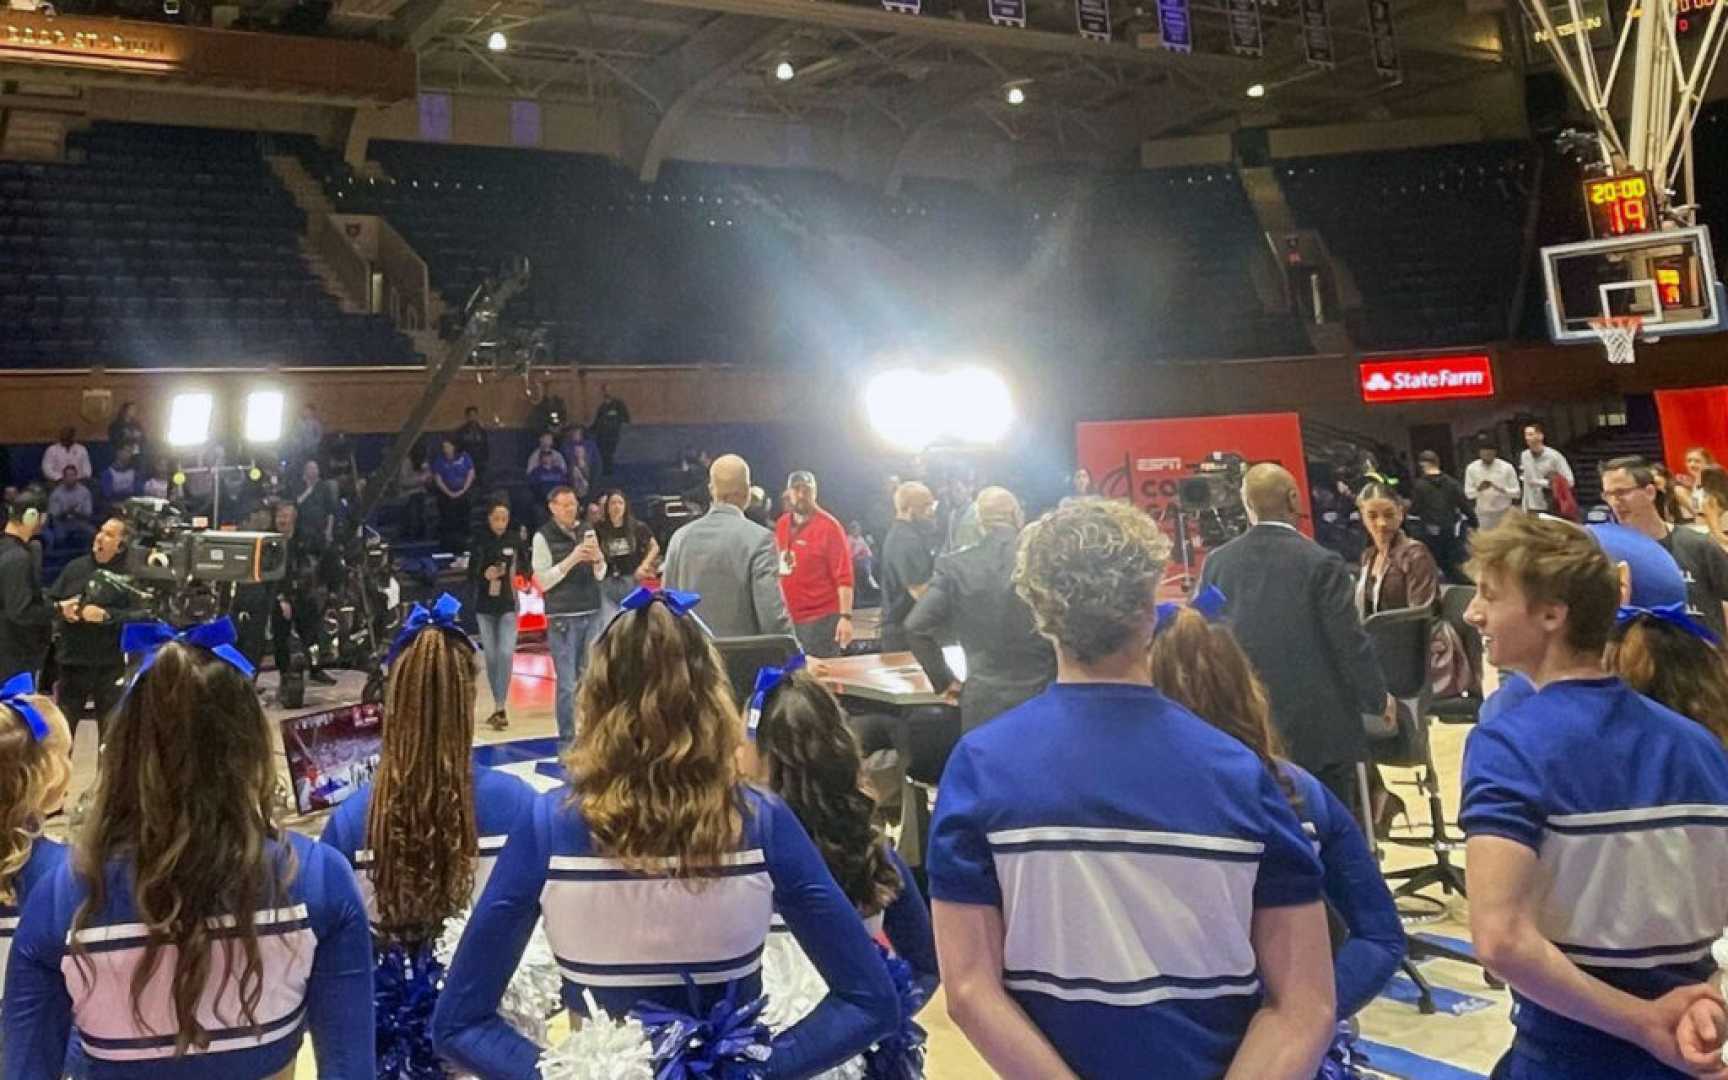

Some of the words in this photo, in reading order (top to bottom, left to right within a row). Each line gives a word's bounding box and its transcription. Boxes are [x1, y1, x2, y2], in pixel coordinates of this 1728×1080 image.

[1591, 178, 1646, 205] 20:00
[1611, 199, 1647, 234] 19
[1136, 457, 1182, 471] ESPN
